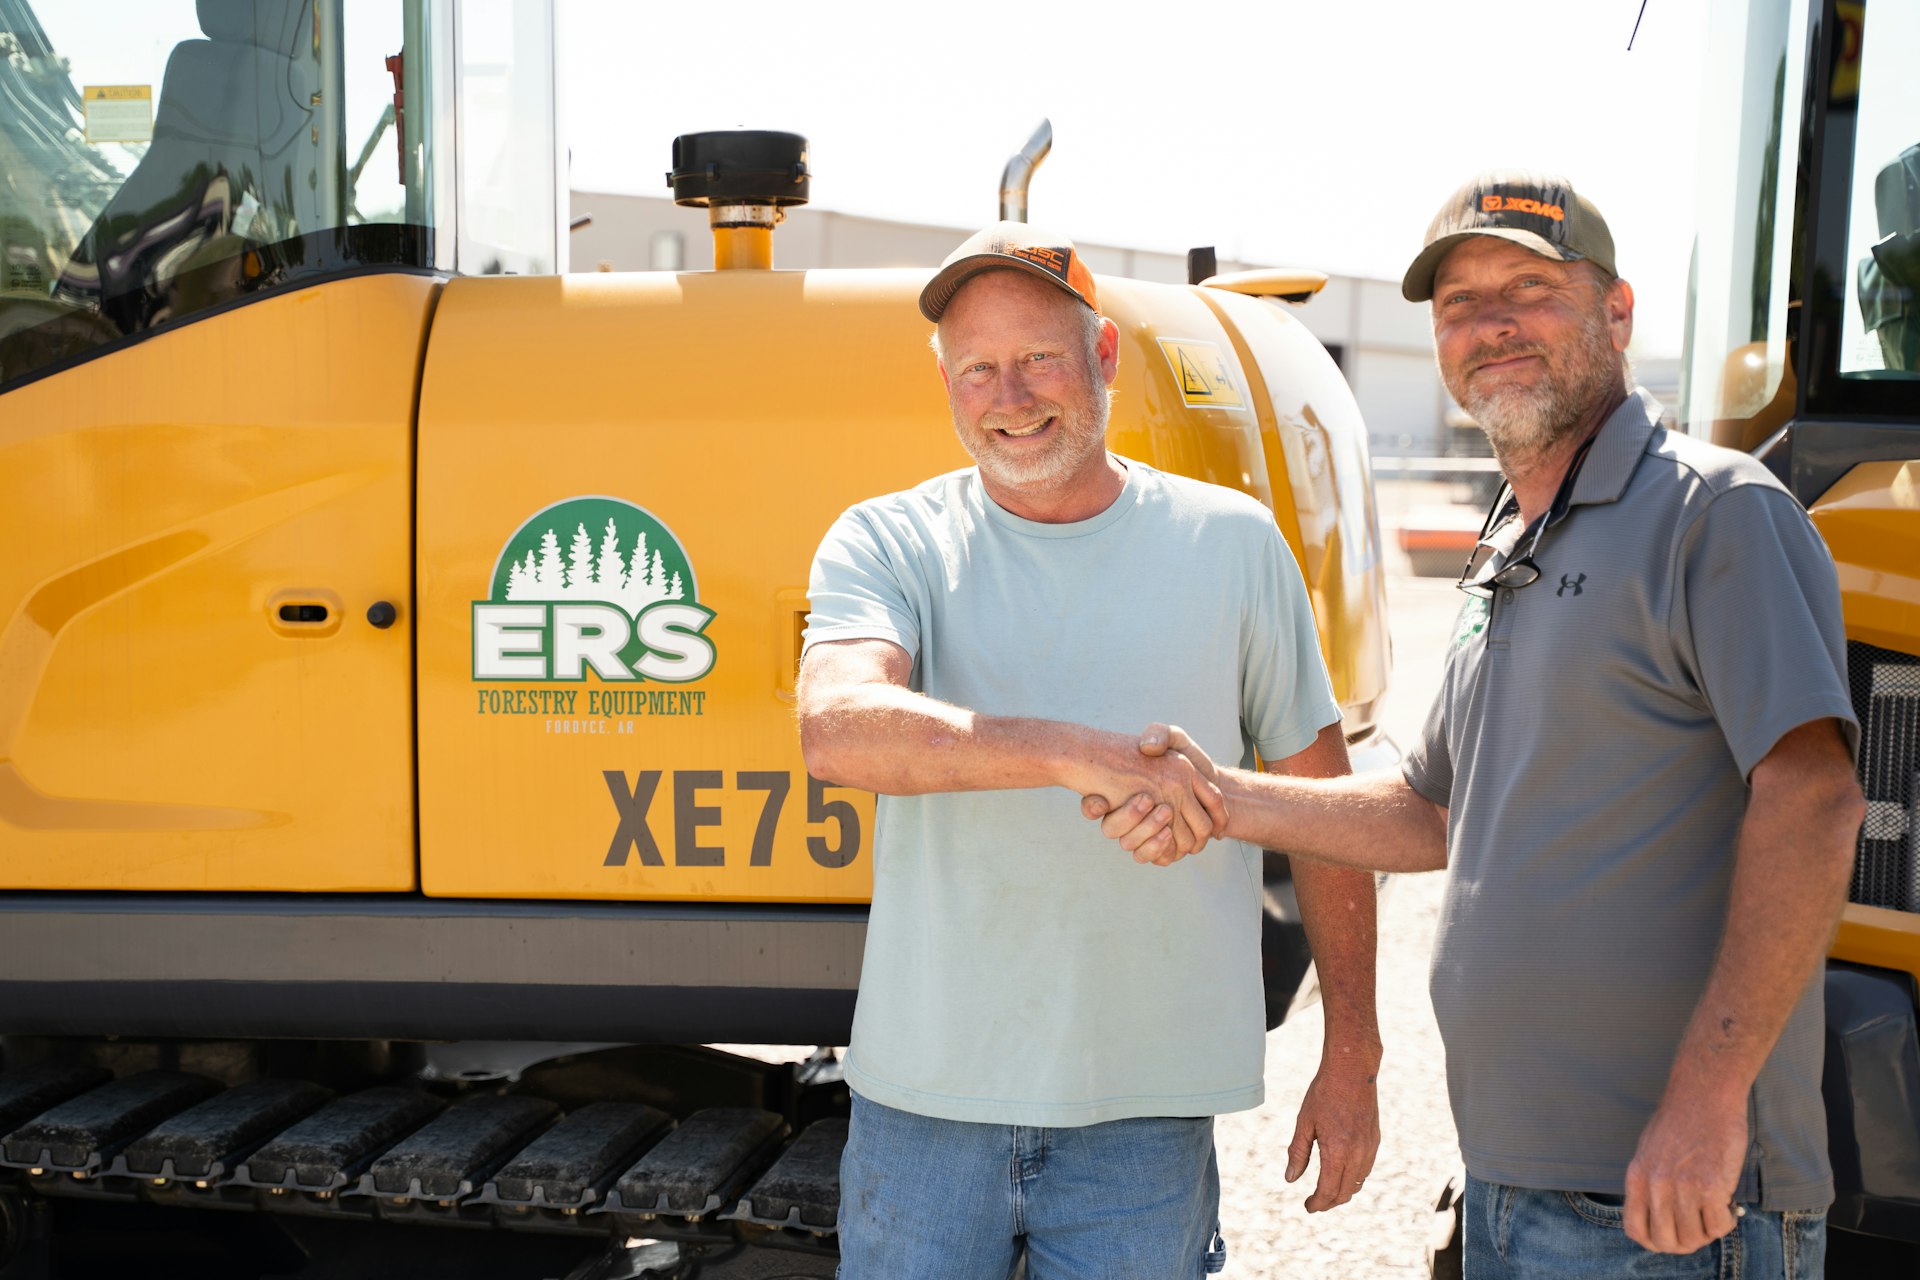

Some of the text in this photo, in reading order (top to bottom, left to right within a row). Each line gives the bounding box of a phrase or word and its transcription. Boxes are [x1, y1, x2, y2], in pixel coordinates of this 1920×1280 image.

[1503, 197, 1564, 221] XCMG
[473, 602, 716, 682] ERS
[477, 690, 706, 718] FORESTRY EQUIPMENT
[618, 720, 634, 735] AR
[602, 770, 861, 868] XE75
